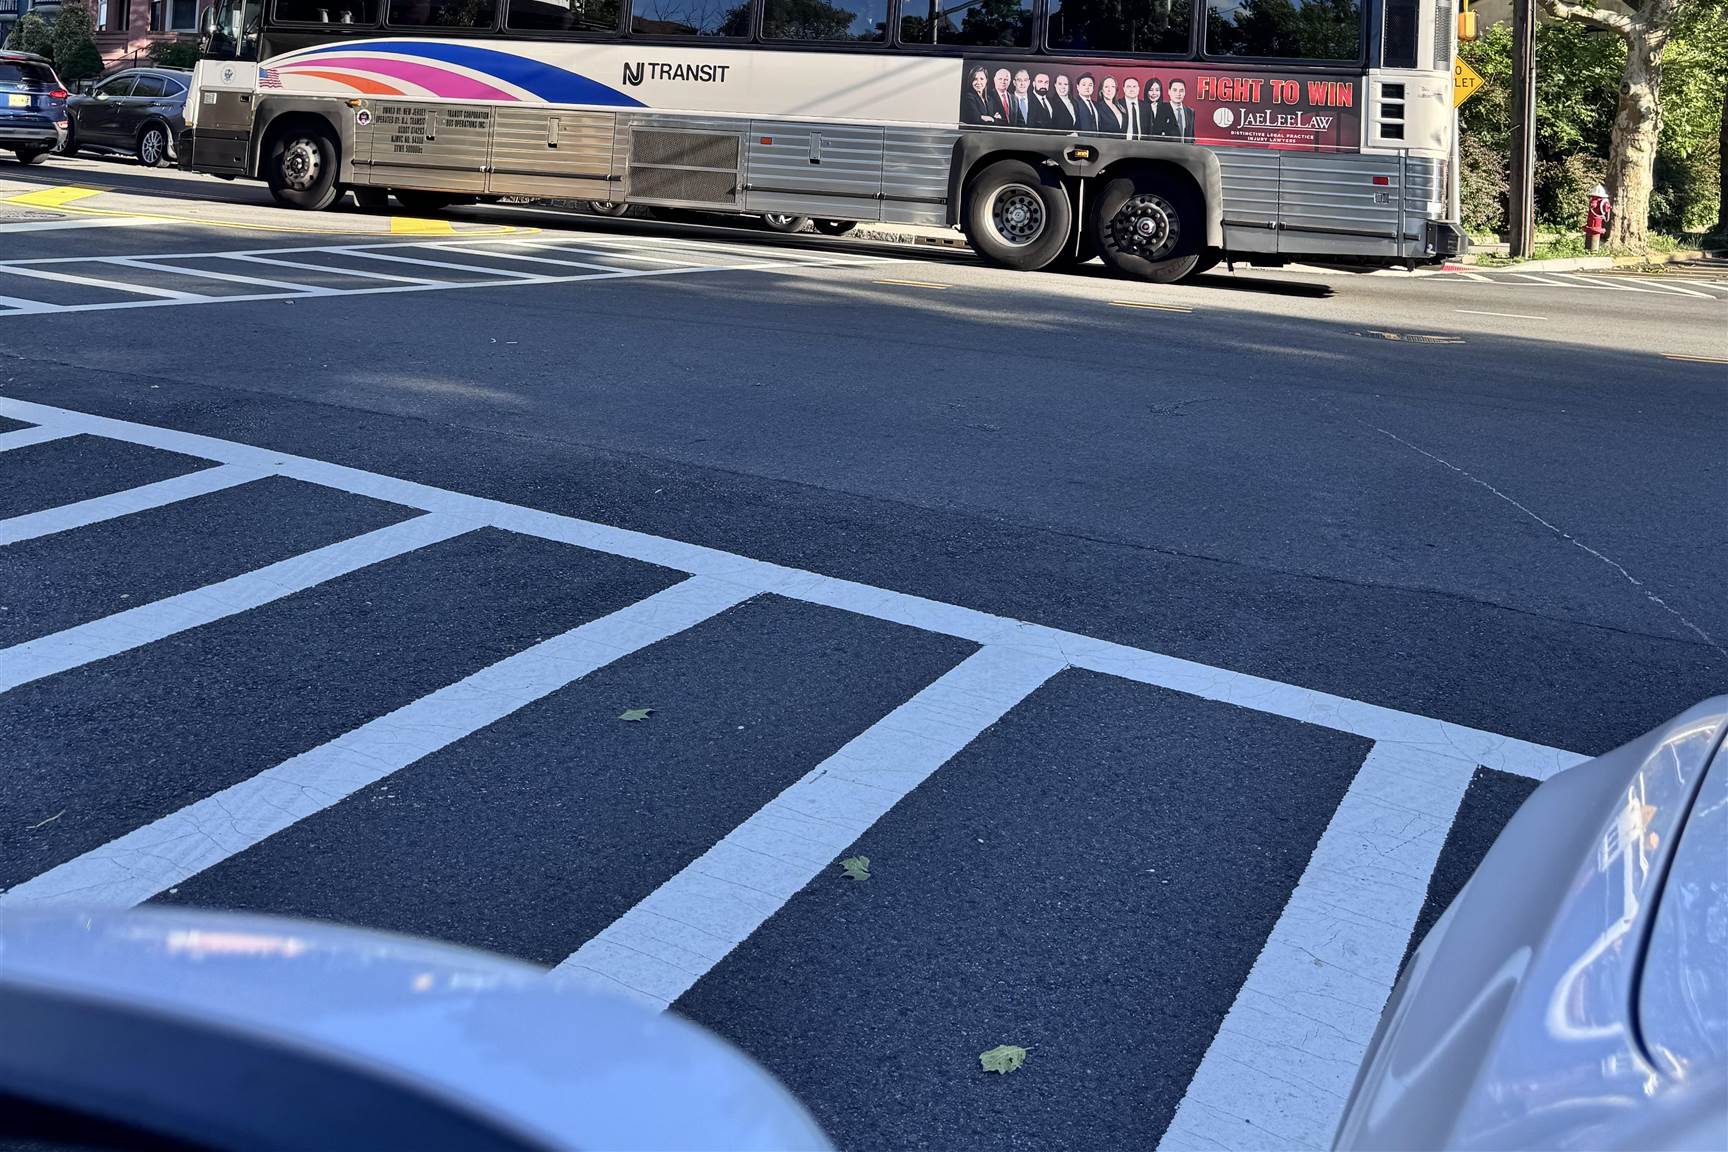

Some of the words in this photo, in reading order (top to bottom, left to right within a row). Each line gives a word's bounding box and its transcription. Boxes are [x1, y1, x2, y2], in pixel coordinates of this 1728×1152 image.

[622, 62, 645, 86] NJ
[648, 62, 730, 82] TRANSIT
[1196, 76, 1264, 103] FIGHT
[1270, 79, 1300, 105] TO
[1307, 81, 1353, 108] WIN
[412, 108, 426, 116] JERSEY
